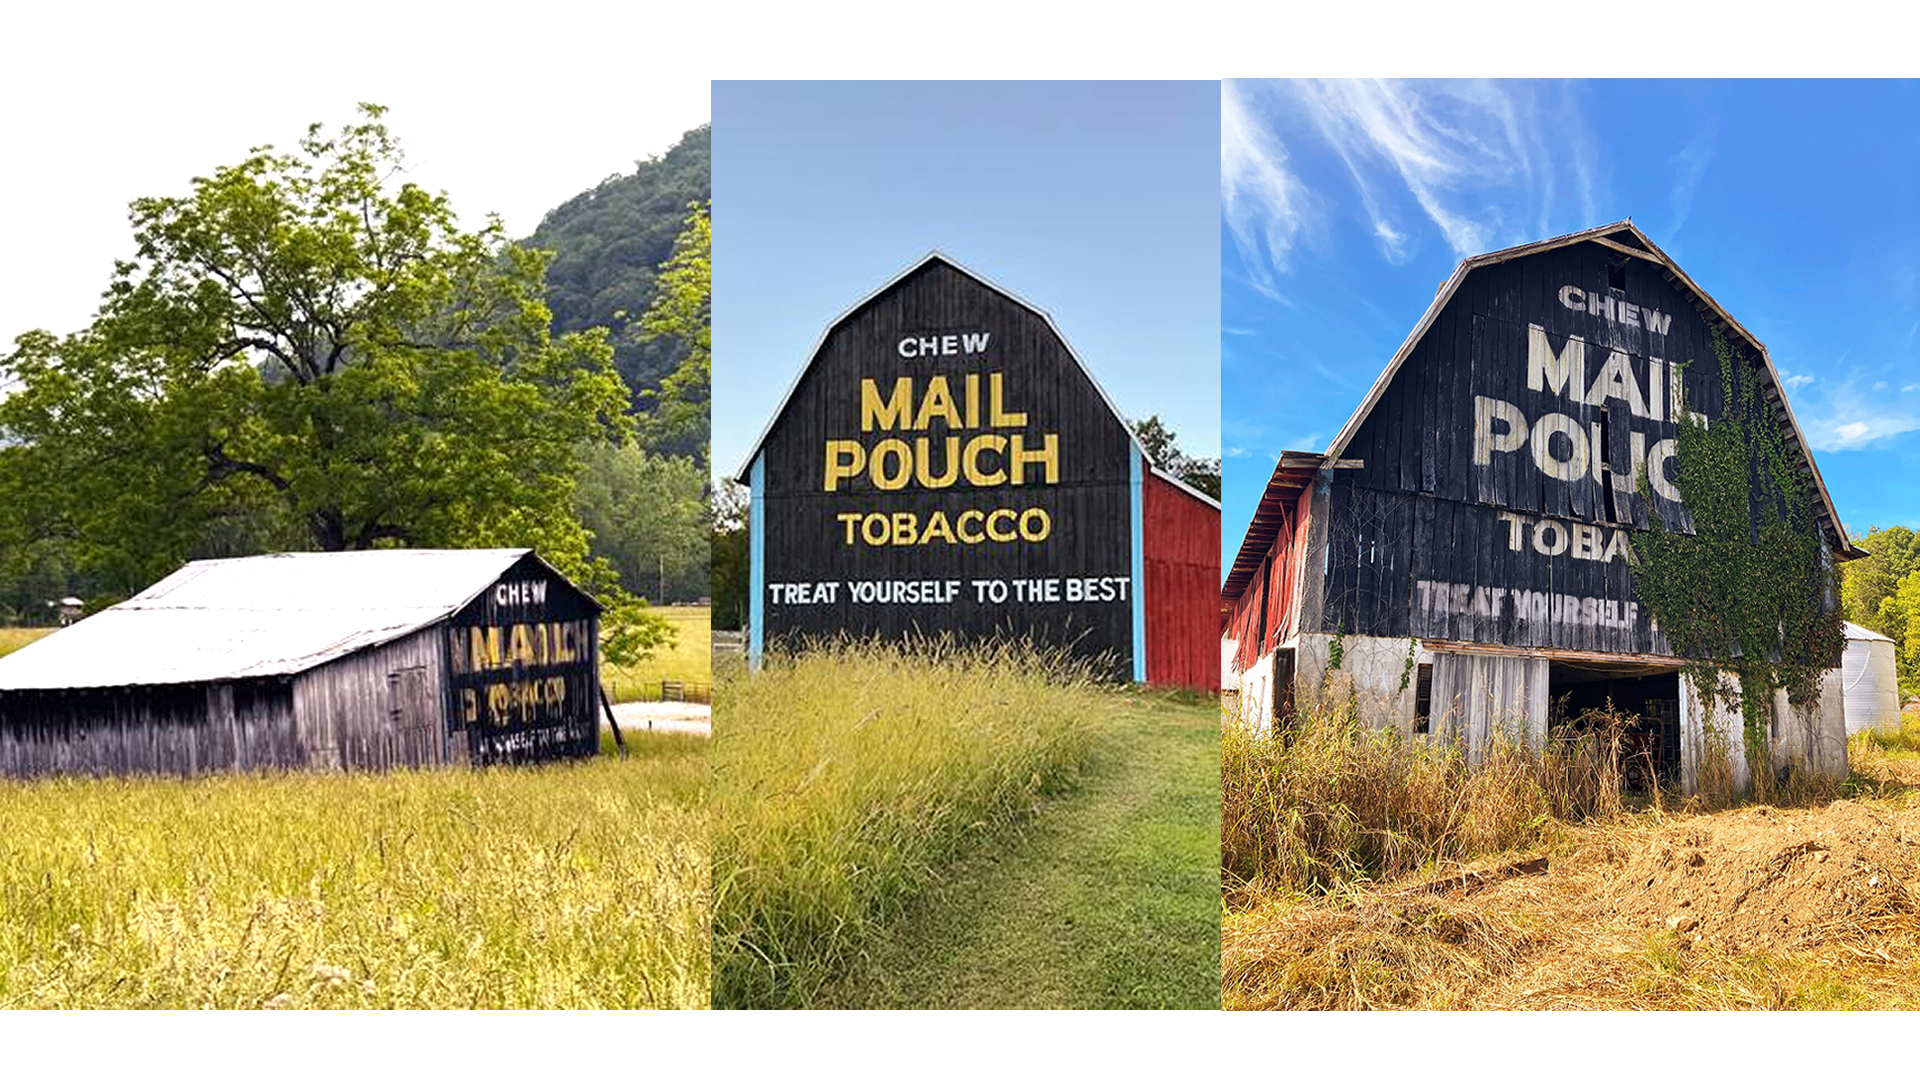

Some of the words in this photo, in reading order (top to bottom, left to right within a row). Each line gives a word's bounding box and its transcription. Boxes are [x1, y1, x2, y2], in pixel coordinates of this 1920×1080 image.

[1557, 285, 1671, 336] CHEW
[898, 332, 990, 358] CHEW
[1526, 322, 1708, 430] MAIL
[860, 372, 1028, 432] MAIL
[824, 433, 1060, 492] POUCH
[1473, 395, 1682, 502] POUC
[837, 507, 1051, 547] TOBACCO
[1499, 511, 1641, 565] TOBA
[496, 579, 547, 605] CHEW
[769, 582, 839, 605] TREAT
[848, 580, 961, 604] YOURSELF
[972, 580, 1008, 604] TO
[1012, 578, 1060, 602] THE
[1065, 576, 1131, 602] BEST
[1416, 579, 1504, 618] TREAT
[1510, 587, 1638, 629] YOURSELF
